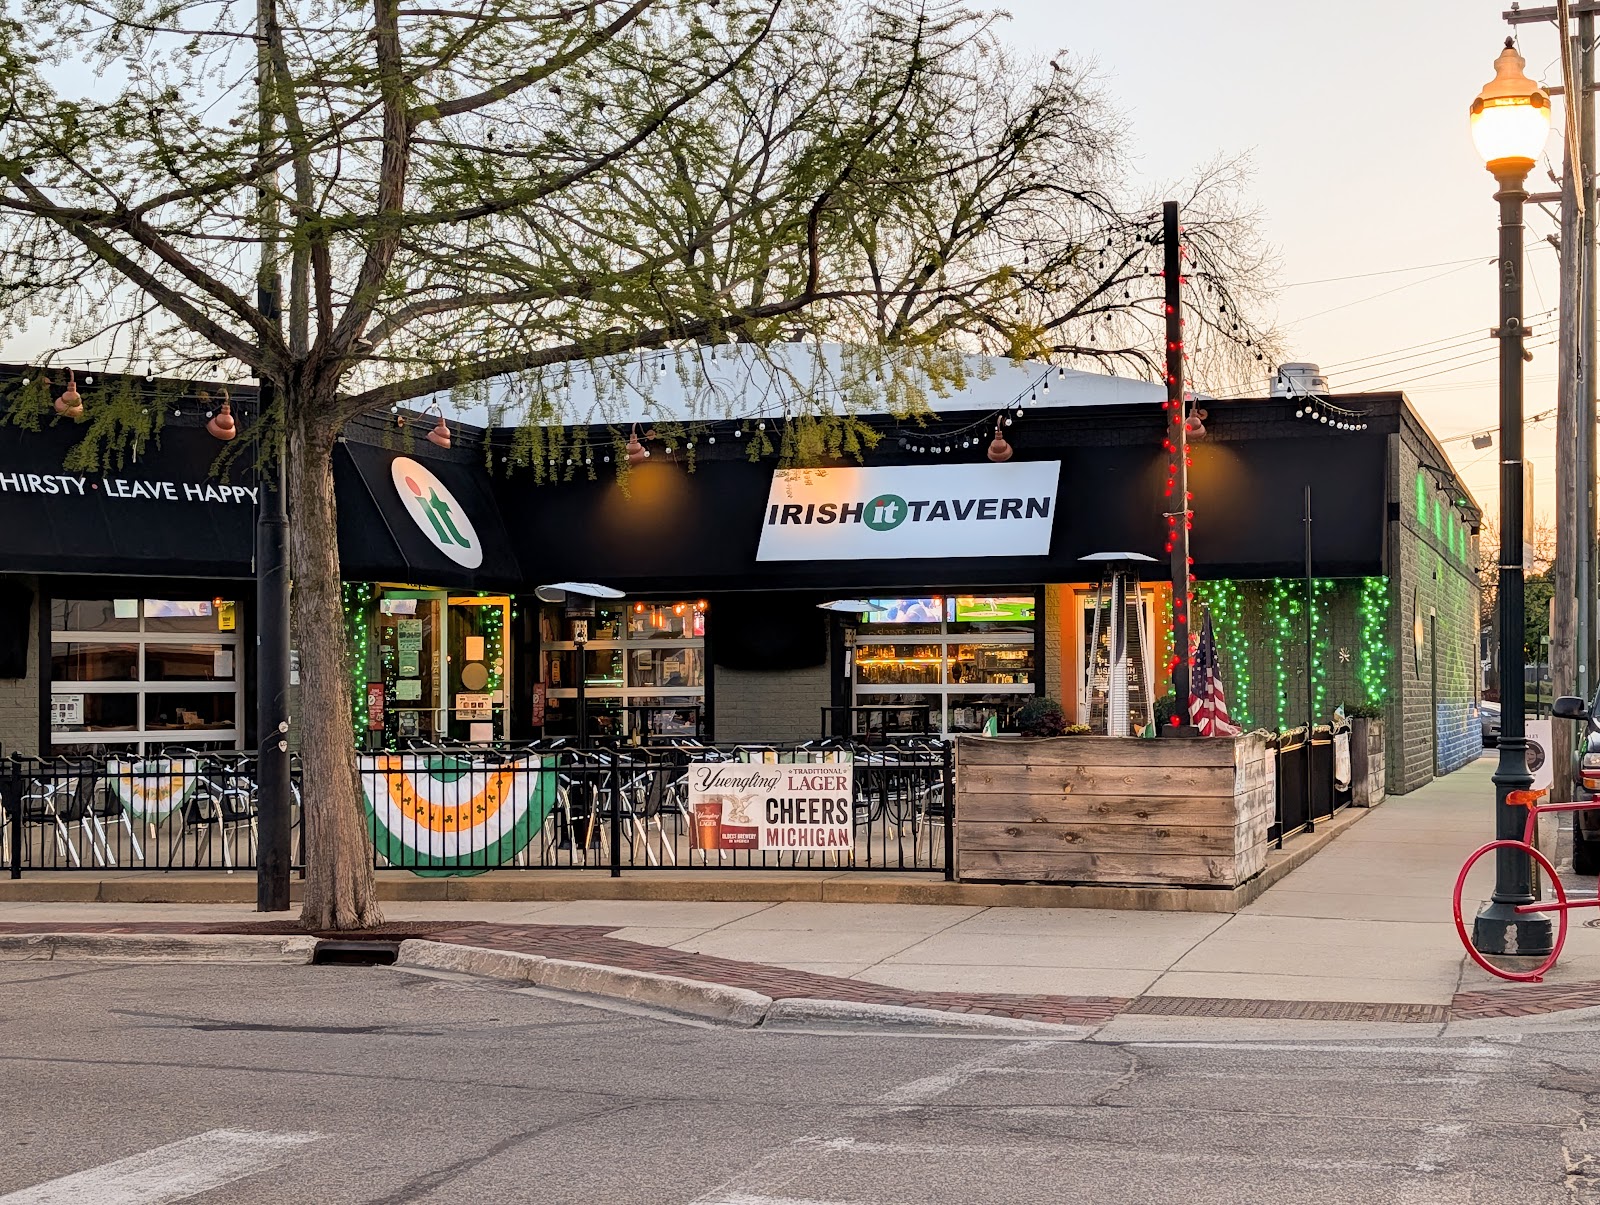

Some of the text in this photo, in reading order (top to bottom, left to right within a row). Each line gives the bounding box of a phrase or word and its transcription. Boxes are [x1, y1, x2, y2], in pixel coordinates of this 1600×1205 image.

[0, 472, 259, 505] HIRSTY LEAVE HAPPY
[405, 475, 472, 549] it
[768, 497, 1051, 525] IRISH it TAVERN
[694, 766, 782, 793] Yuengling
[788, 776, 848, 791] LAGER
[765, 798, 849, 825] CHEERS
[766, 828, 849, 847] MICHIGAN
